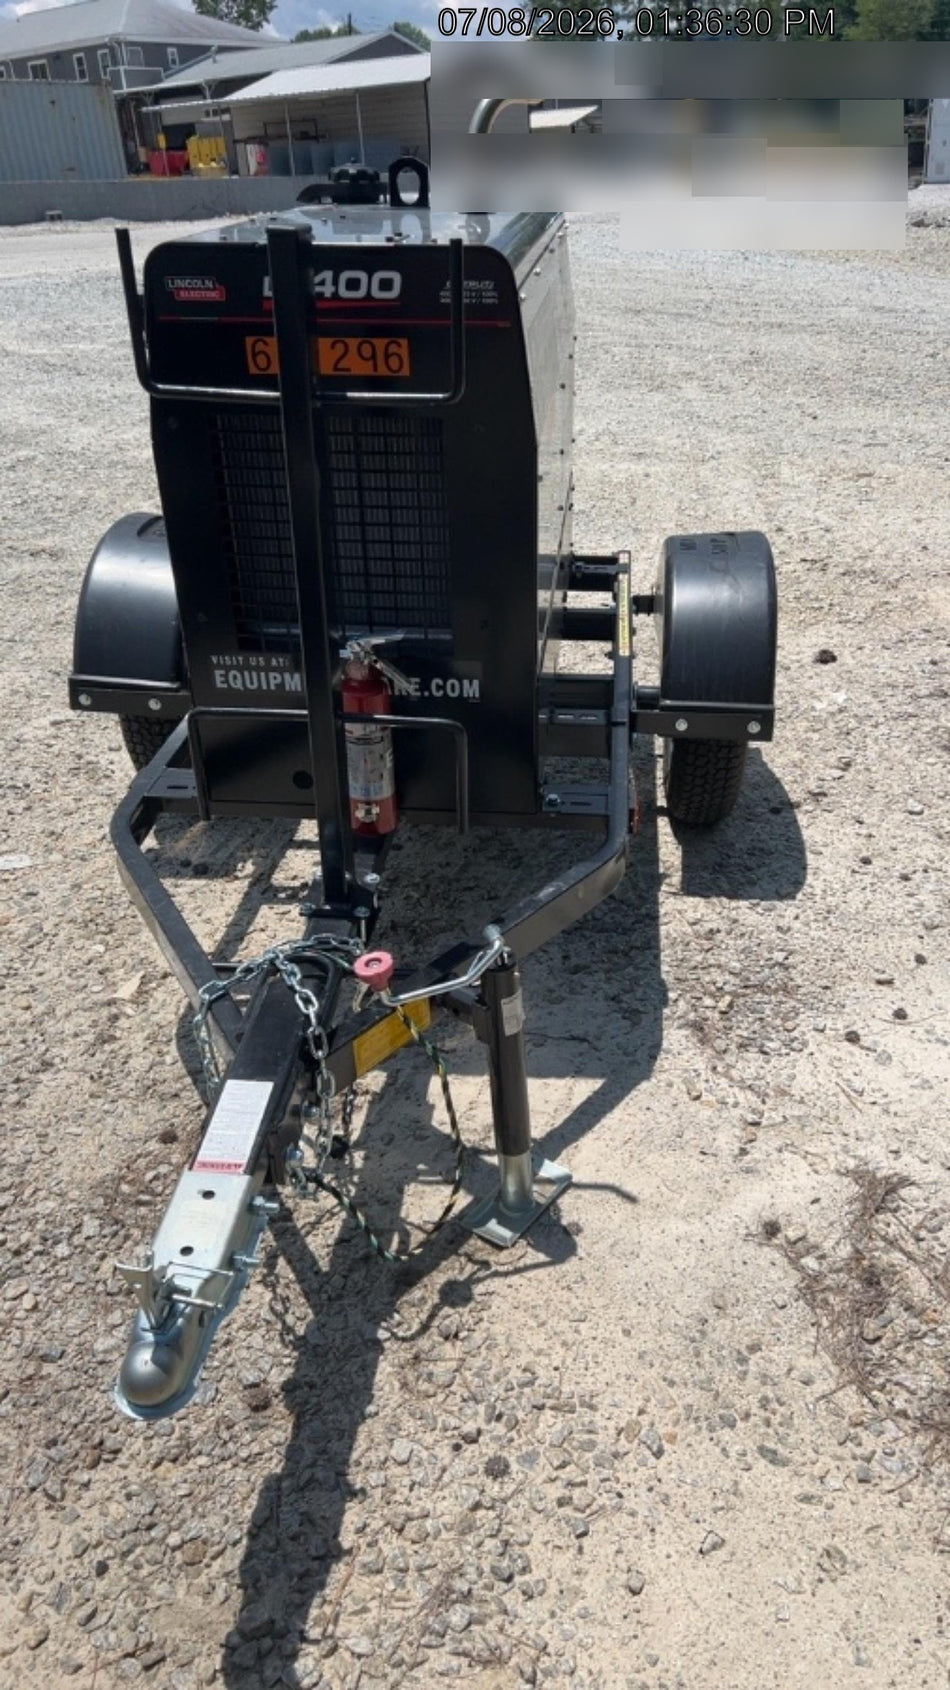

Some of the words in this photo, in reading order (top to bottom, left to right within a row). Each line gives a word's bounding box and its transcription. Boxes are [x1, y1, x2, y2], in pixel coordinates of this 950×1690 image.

[168, 279, 213, 288] LINCOLN
[251, 337, 405, 375] 6296
[210, 655, 243, 665] VISIT
[249, 656, 265, 667] US
[271, 657, 290, 667] AT:
